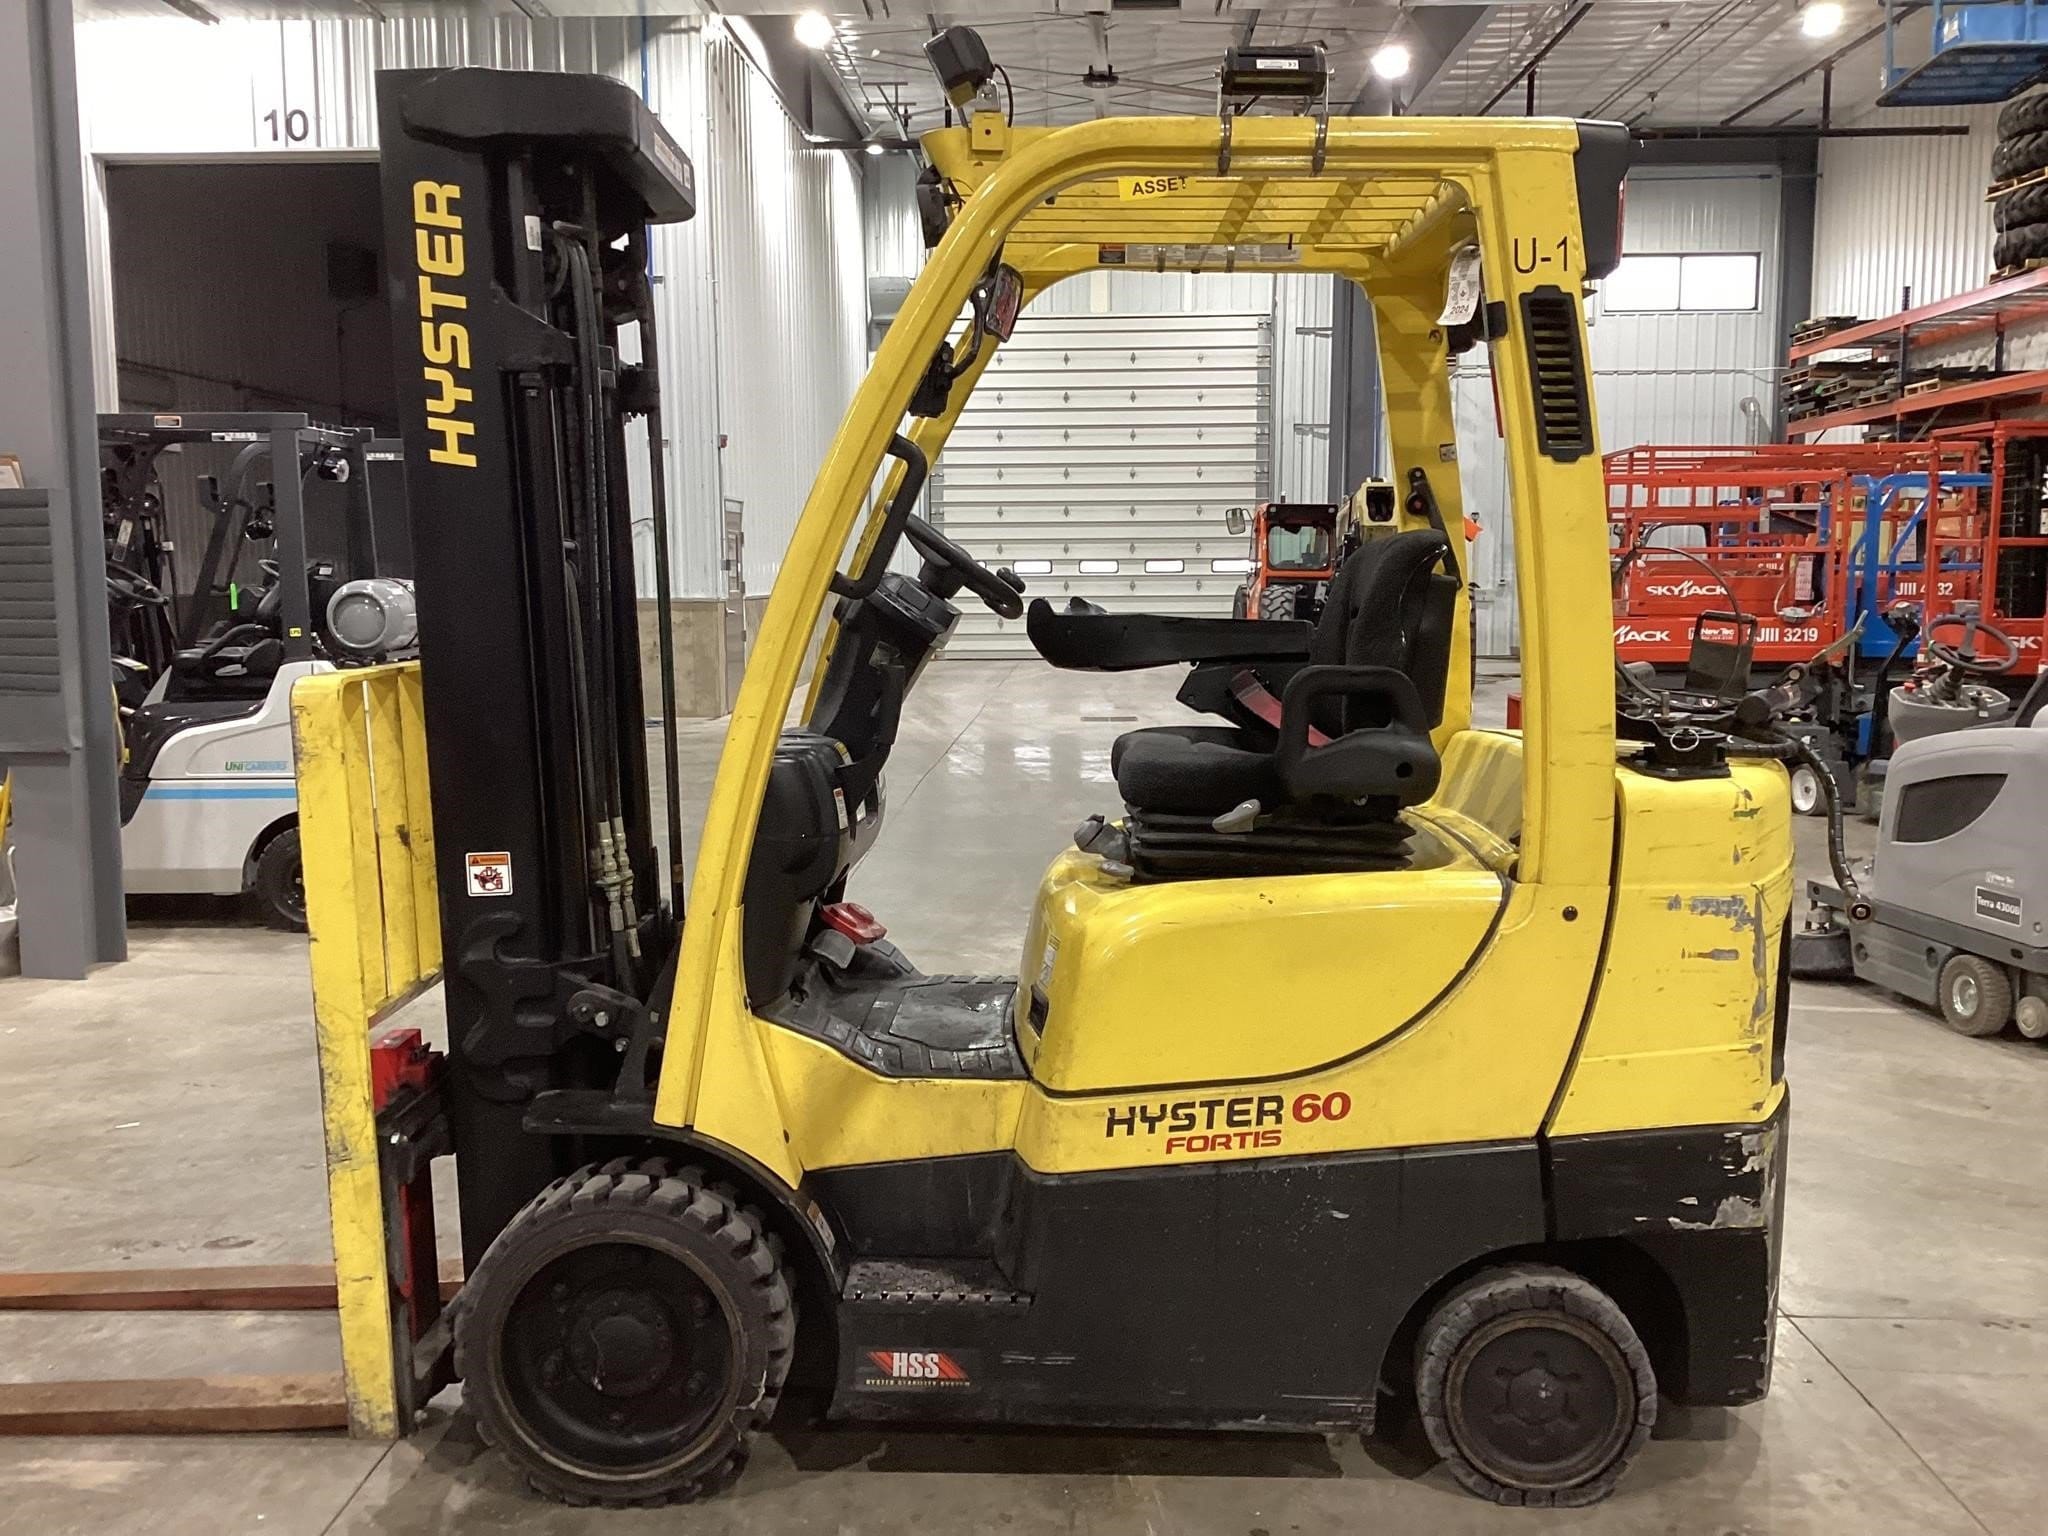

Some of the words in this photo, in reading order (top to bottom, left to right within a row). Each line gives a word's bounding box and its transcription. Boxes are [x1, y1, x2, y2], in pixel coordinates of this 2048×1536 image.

[263, 109, 309, 141] 10
[1132, 176, 1188, 196] ASSET
[1514, 236, 1567, 273] U-1
[413, 180, 478, 467] HYSTER
[1645, 580, 1728, 598] SKYJACK
[1783, 627, 1818, 642] 3219
[1106, 1095, 1285, 1137] HYSTER
[1292, 1091, 1352, 1123] 60
[1165, 1129, 1283, 1154] FORTIS
[892, 1352, 940, 1378] HSS
